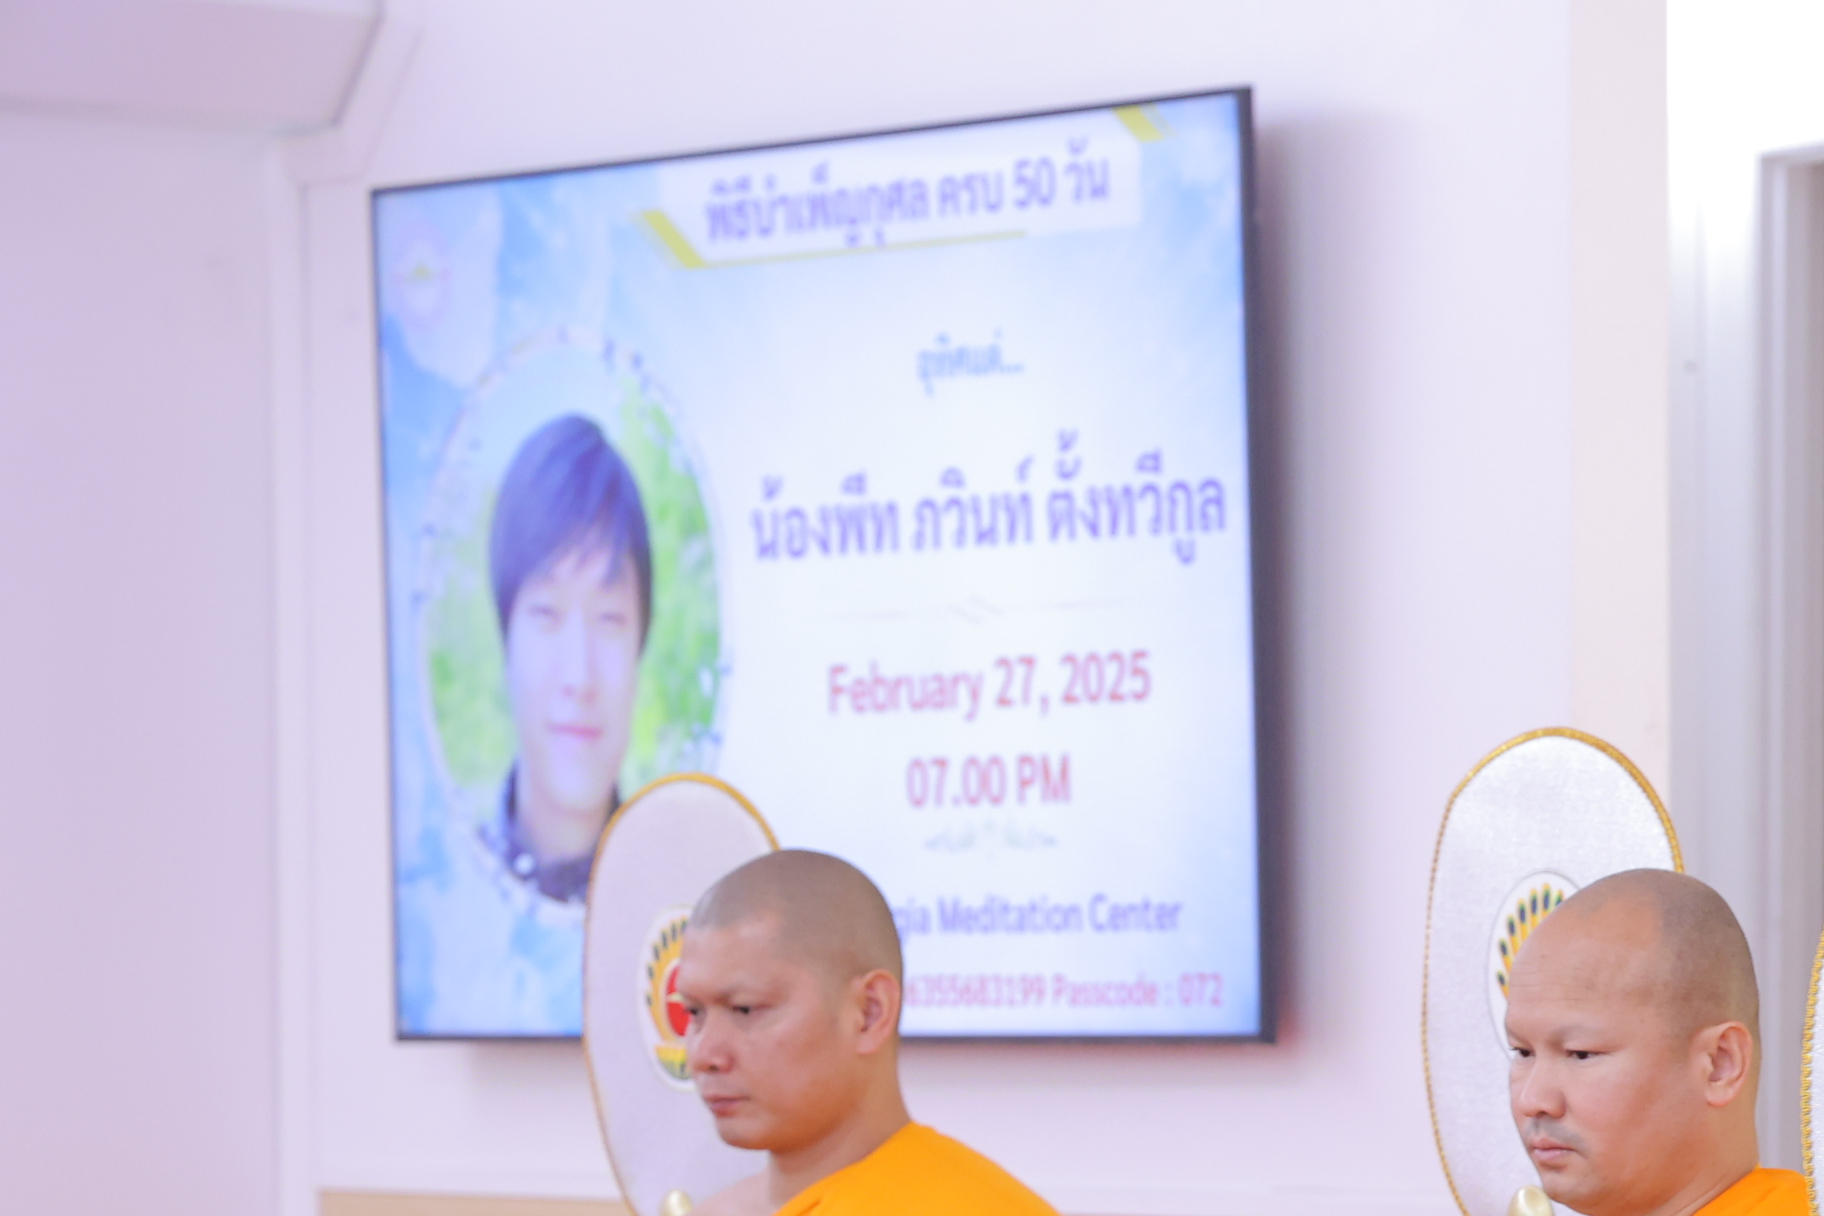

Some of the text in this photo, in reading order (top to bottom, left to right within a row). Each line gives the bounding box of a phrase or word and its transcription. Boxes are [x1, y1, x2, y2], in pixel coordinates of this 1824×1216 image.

[937, 171, 1005, 216] ครบ
[1013, 156, 1056, 209] 50
[1065, 137, 1110, 203] วัน
[752, 472, 899, 560] น้องพีท
[913, 454, 1034, 551] ภวินท์
[828, 650, 1152, 722] February 27, 2025
[907, 753, 1072, 807] 07.00 PM
[937, 896, 1082, 935] Meditation
[1088, 892, 1183, 933] Center
[1051, 972, 1160, 1006] Passcode
[1177, 971, 1224, 1006] 072
